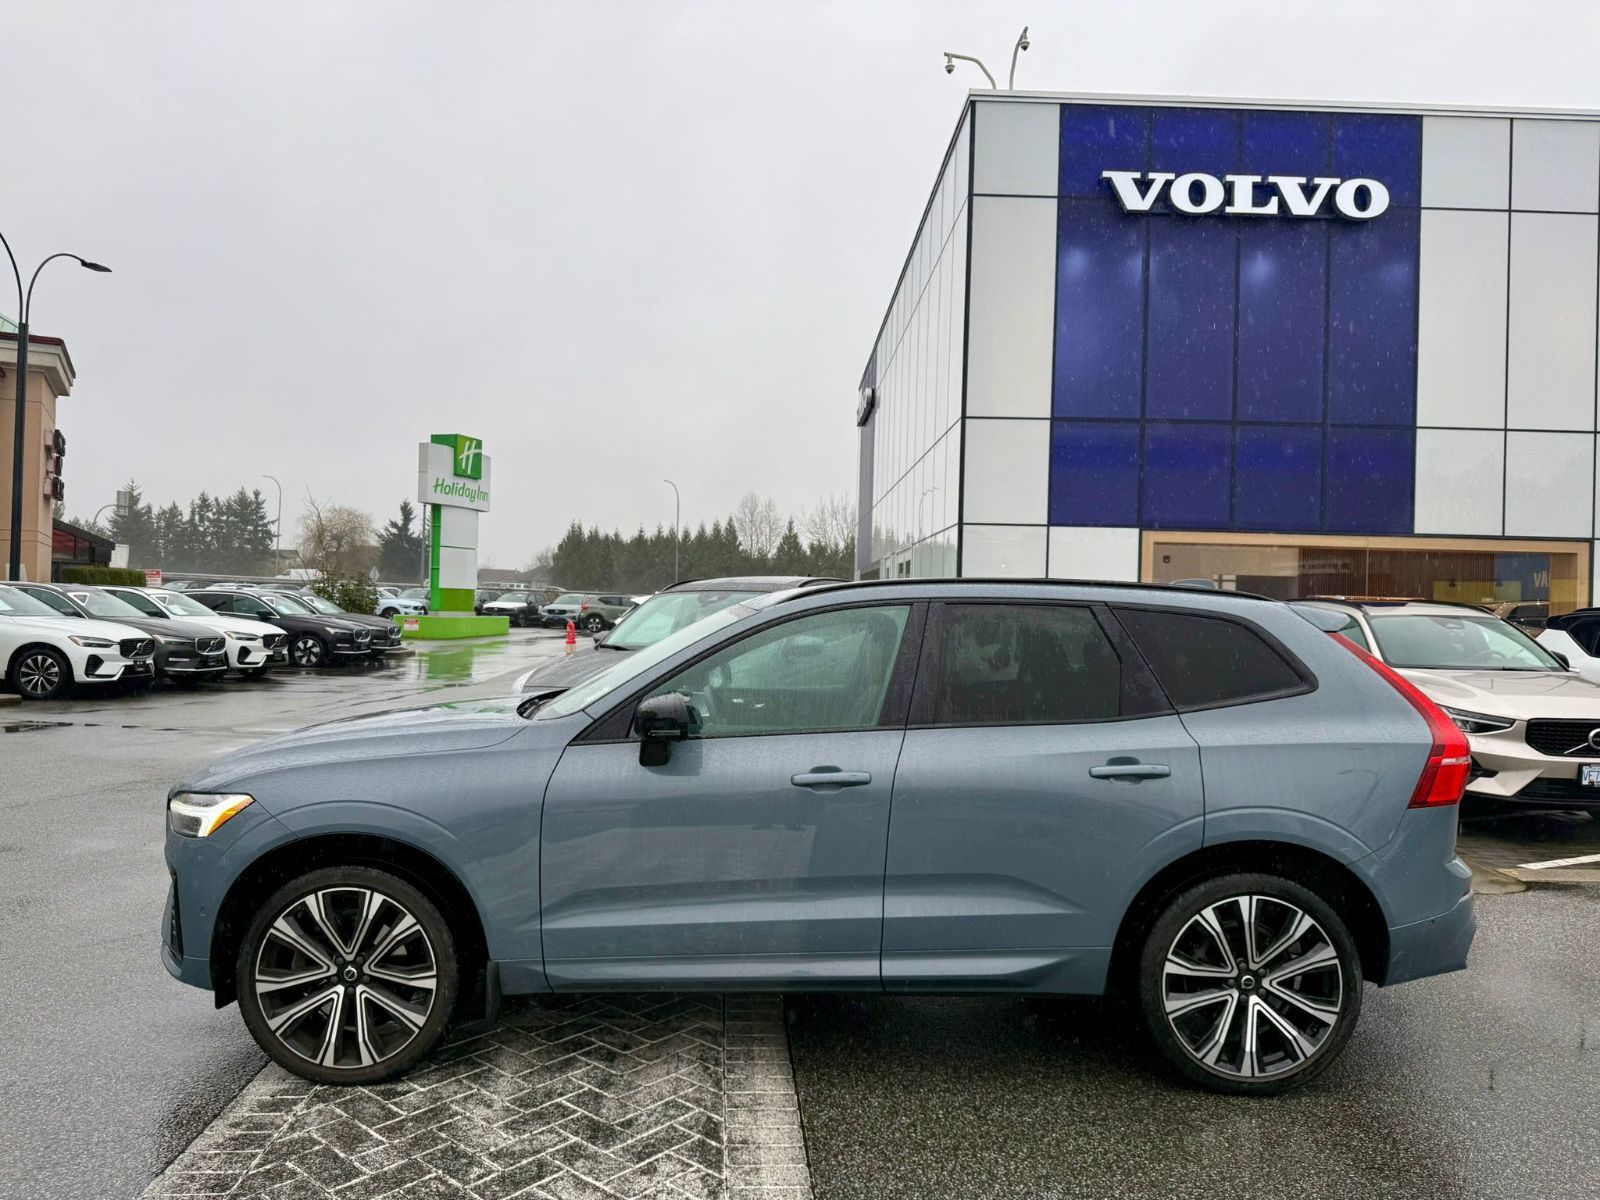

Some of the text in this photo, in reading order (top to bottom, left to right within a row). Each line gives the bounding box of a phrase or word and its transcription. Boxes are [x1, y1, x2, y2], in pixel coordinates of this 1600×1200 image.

[1102, 170, 1390, 219] VOLVO
[433, 477, 489, 502] Holiday Inn
